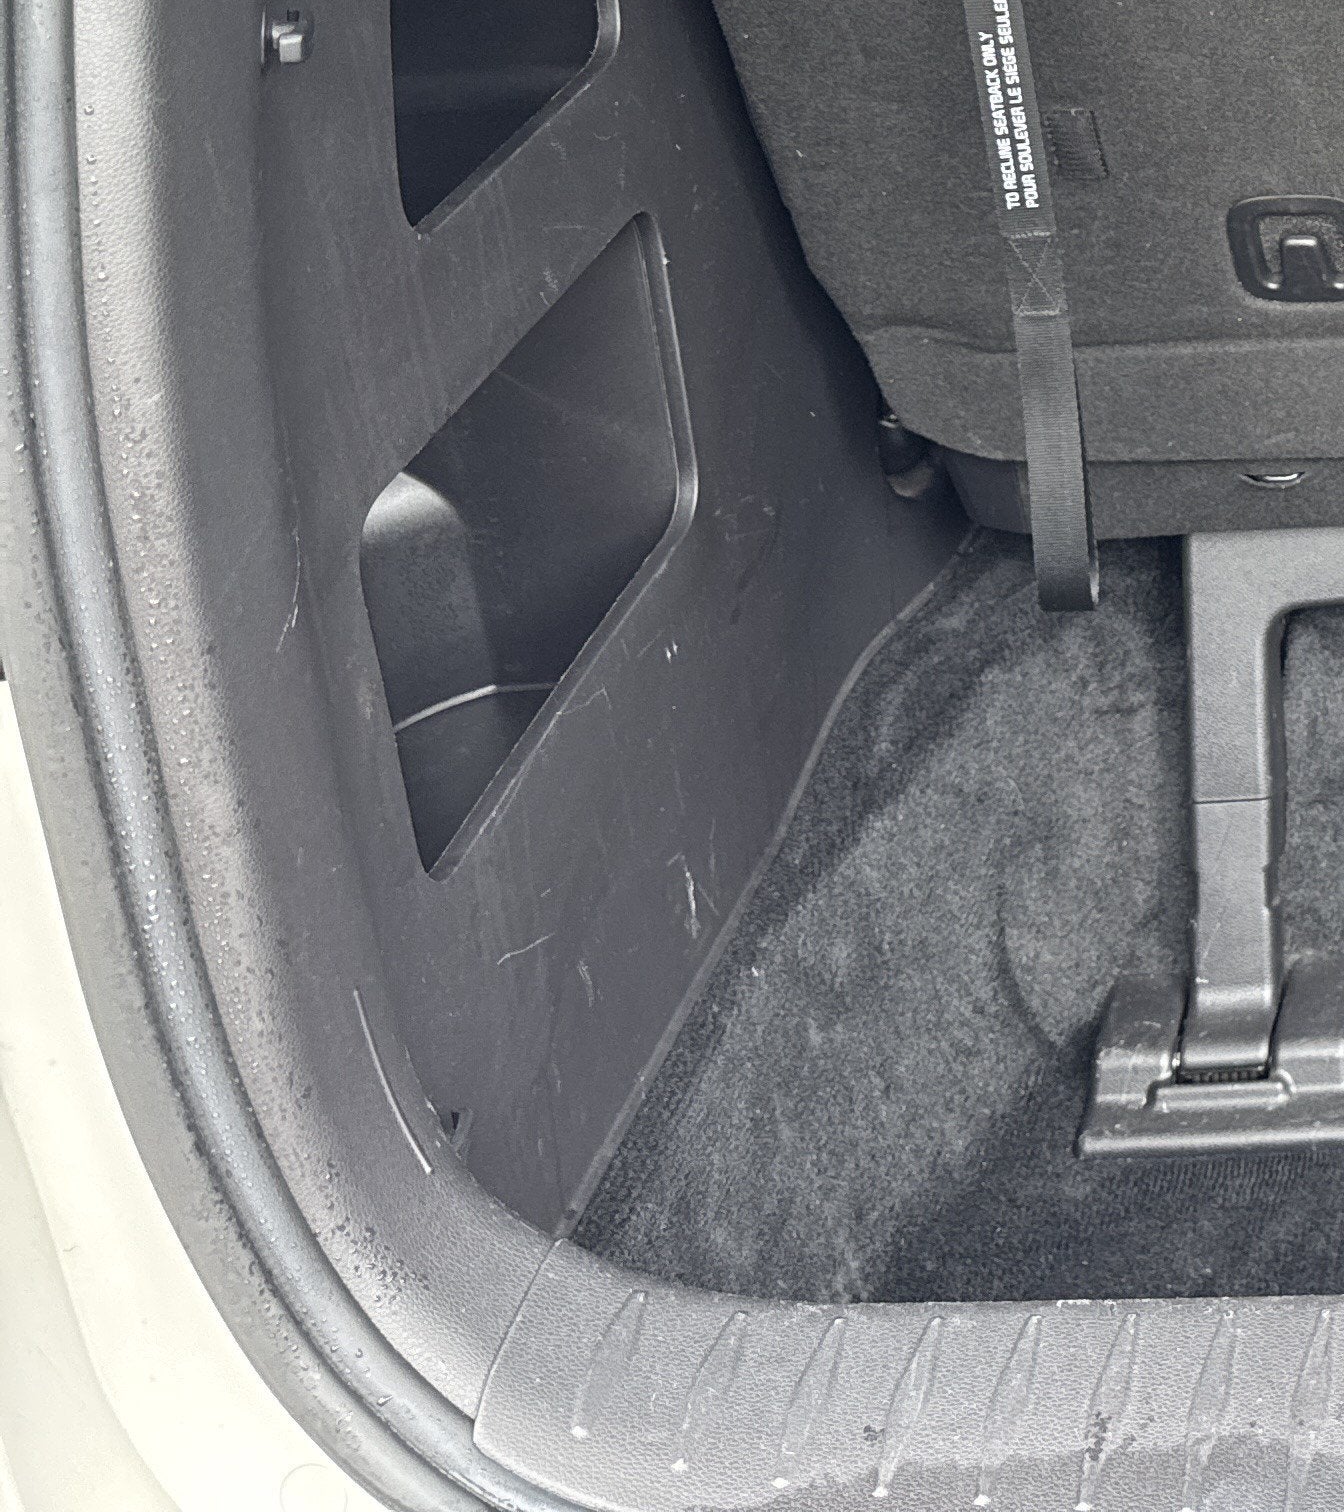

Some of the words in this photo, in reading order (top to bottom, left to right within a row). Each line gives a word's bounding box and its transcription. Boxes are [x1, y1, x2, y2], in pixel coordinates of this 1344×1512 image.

[978, 32, 997, 66] ONLY
[1001, 47, 1020, 85] SIEGE
[984, 69, 1009, 135] SEATBACK
[1007, 87, 1023, 104] LE
[1010, 106, 1034, 171] SOULEVER
[996, 138, 1018, 189] RECLINE
[1005, 192, 1021, 210] TO
[1021, 174, 1039, 208] POUR
